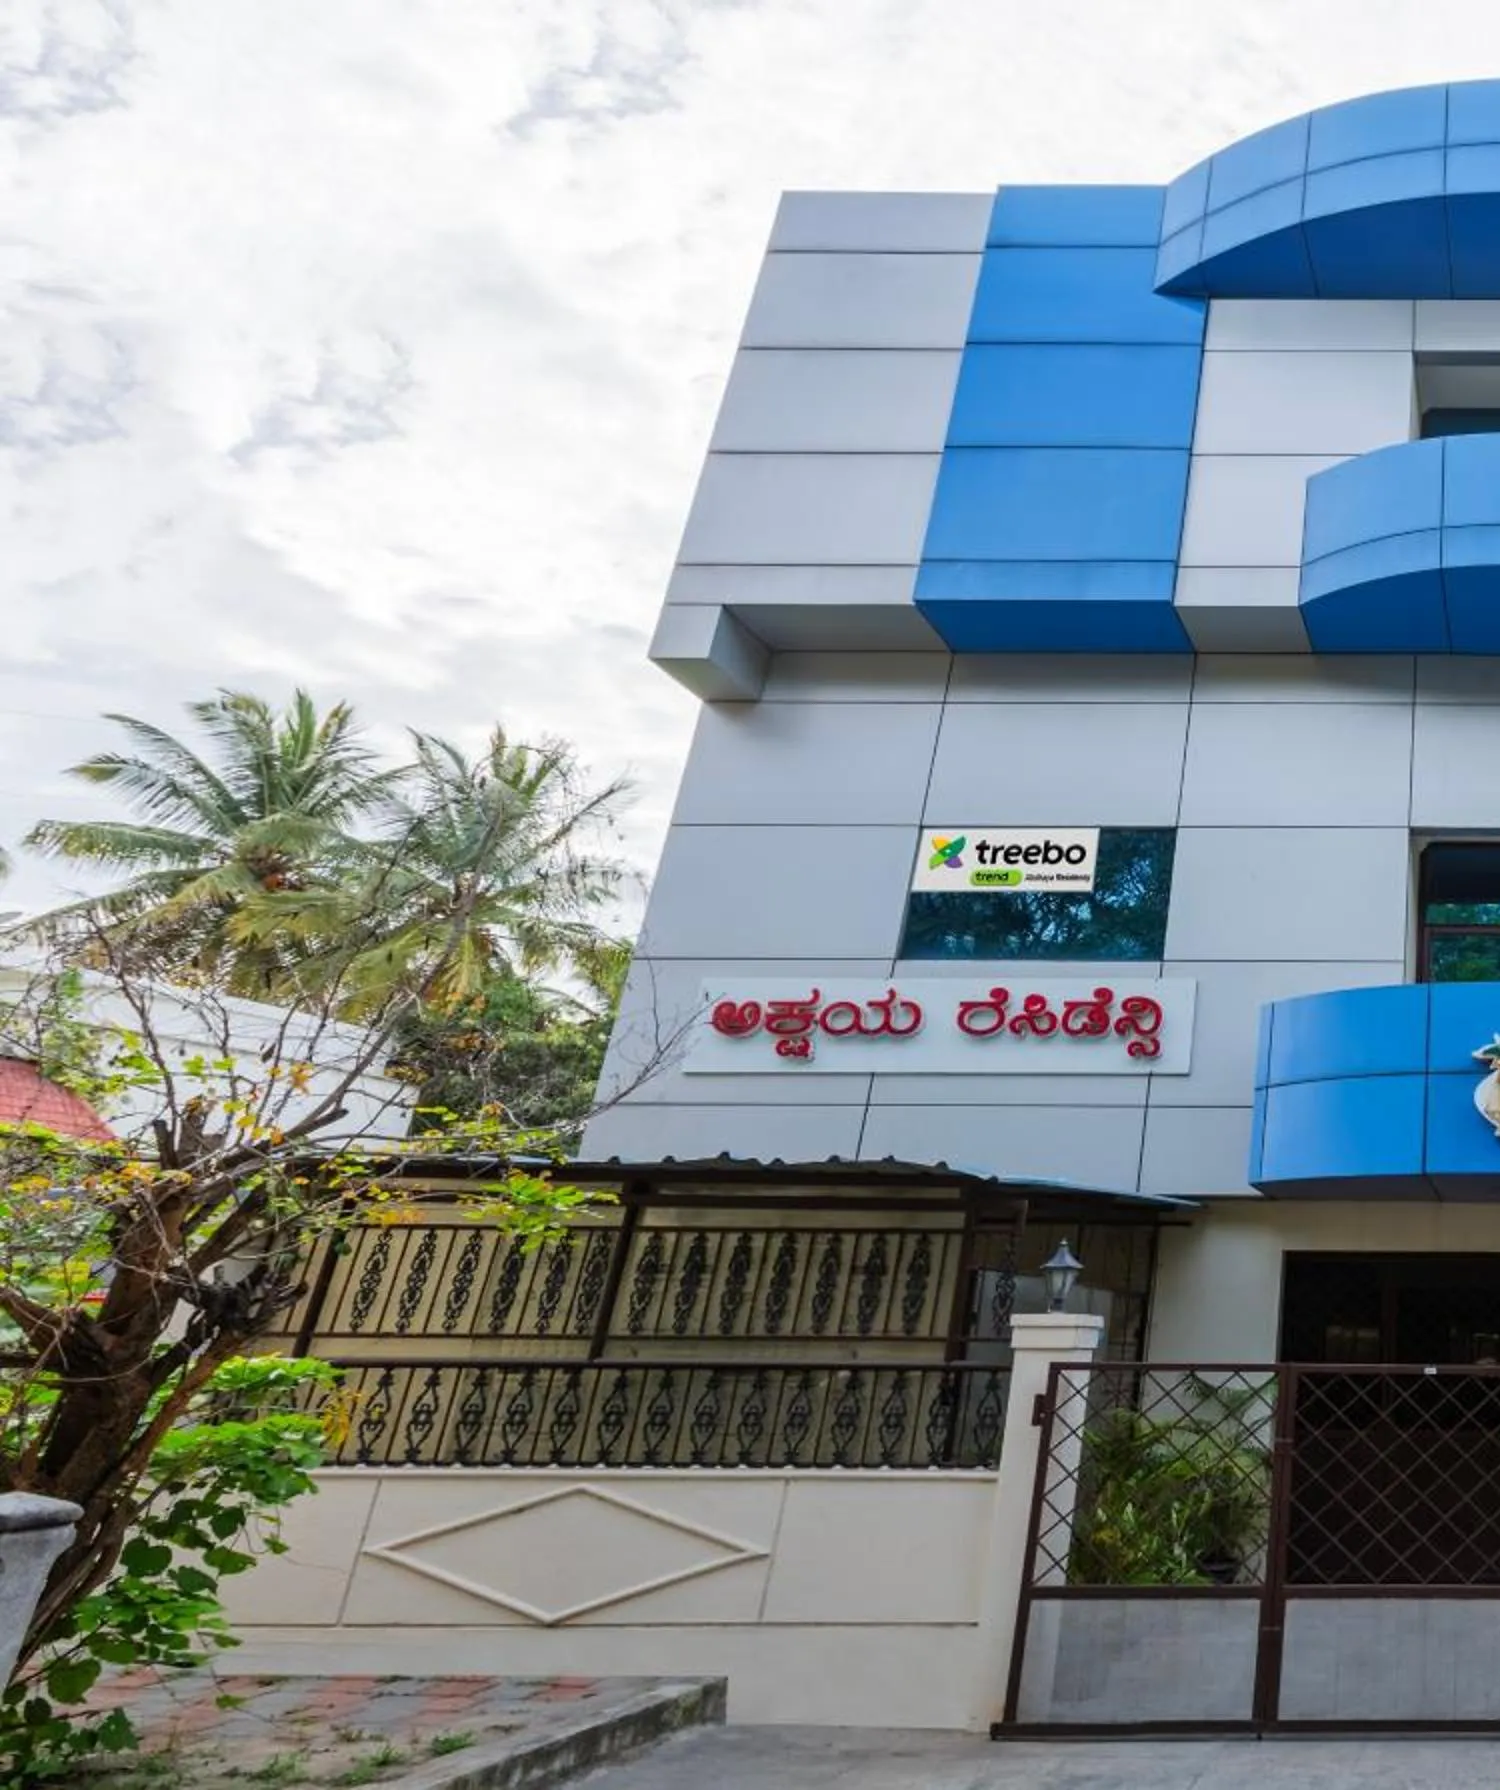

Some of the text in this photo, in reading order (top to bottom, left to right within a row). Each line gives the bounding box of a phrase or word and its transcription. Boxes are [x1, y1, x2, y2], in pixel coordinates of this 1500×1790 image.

[975, 840, 1087, 865] treebo
[975, 871, 1009, 882] trend
[711, 987, 923, 1058] ಅಕ್ಷಯ
